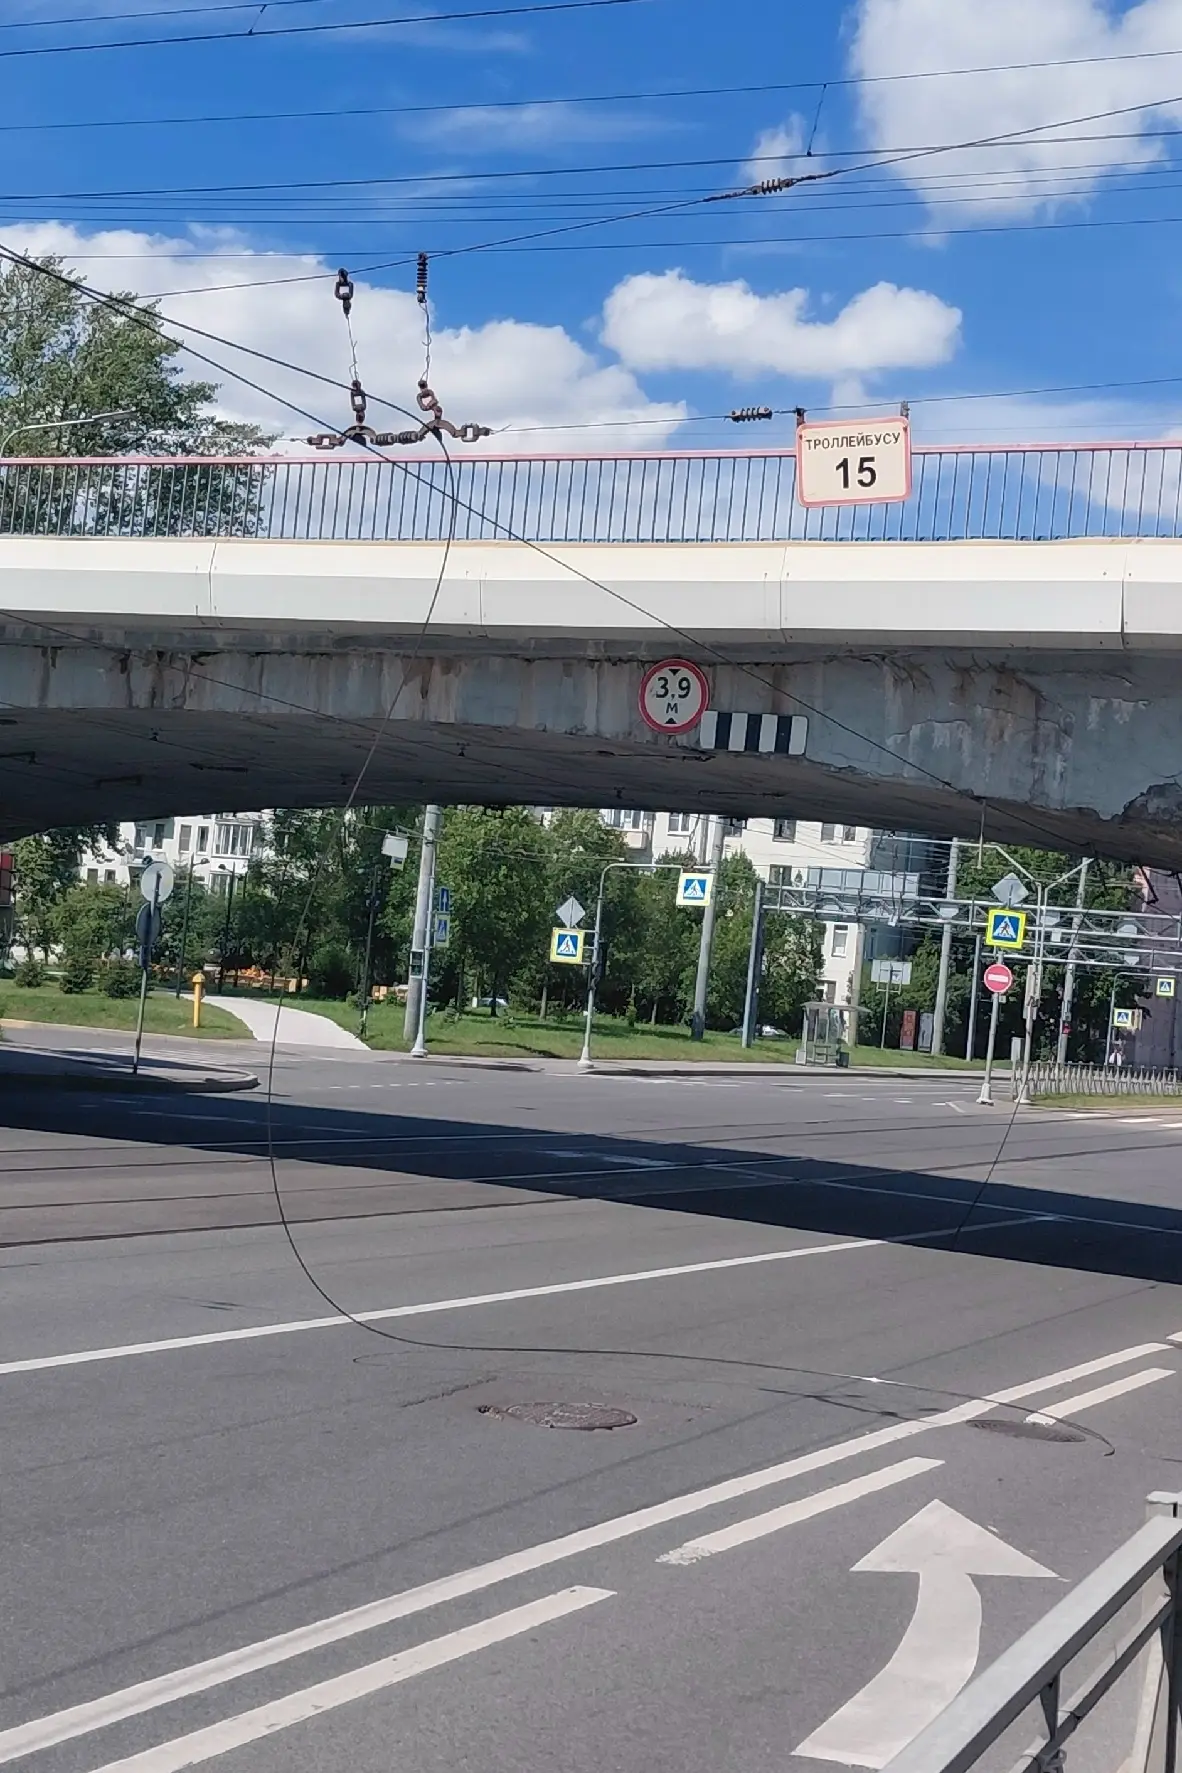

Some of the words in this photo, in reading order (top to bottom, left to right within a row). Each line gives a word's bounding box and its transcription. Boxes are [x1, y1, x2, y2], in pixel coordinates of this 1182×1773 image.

[806, 432, 900, 450] ТРОЛЛЕЙБУСУ
[835, 456, 876, 489] 15
[656, 677, 691, 700] 3,9
